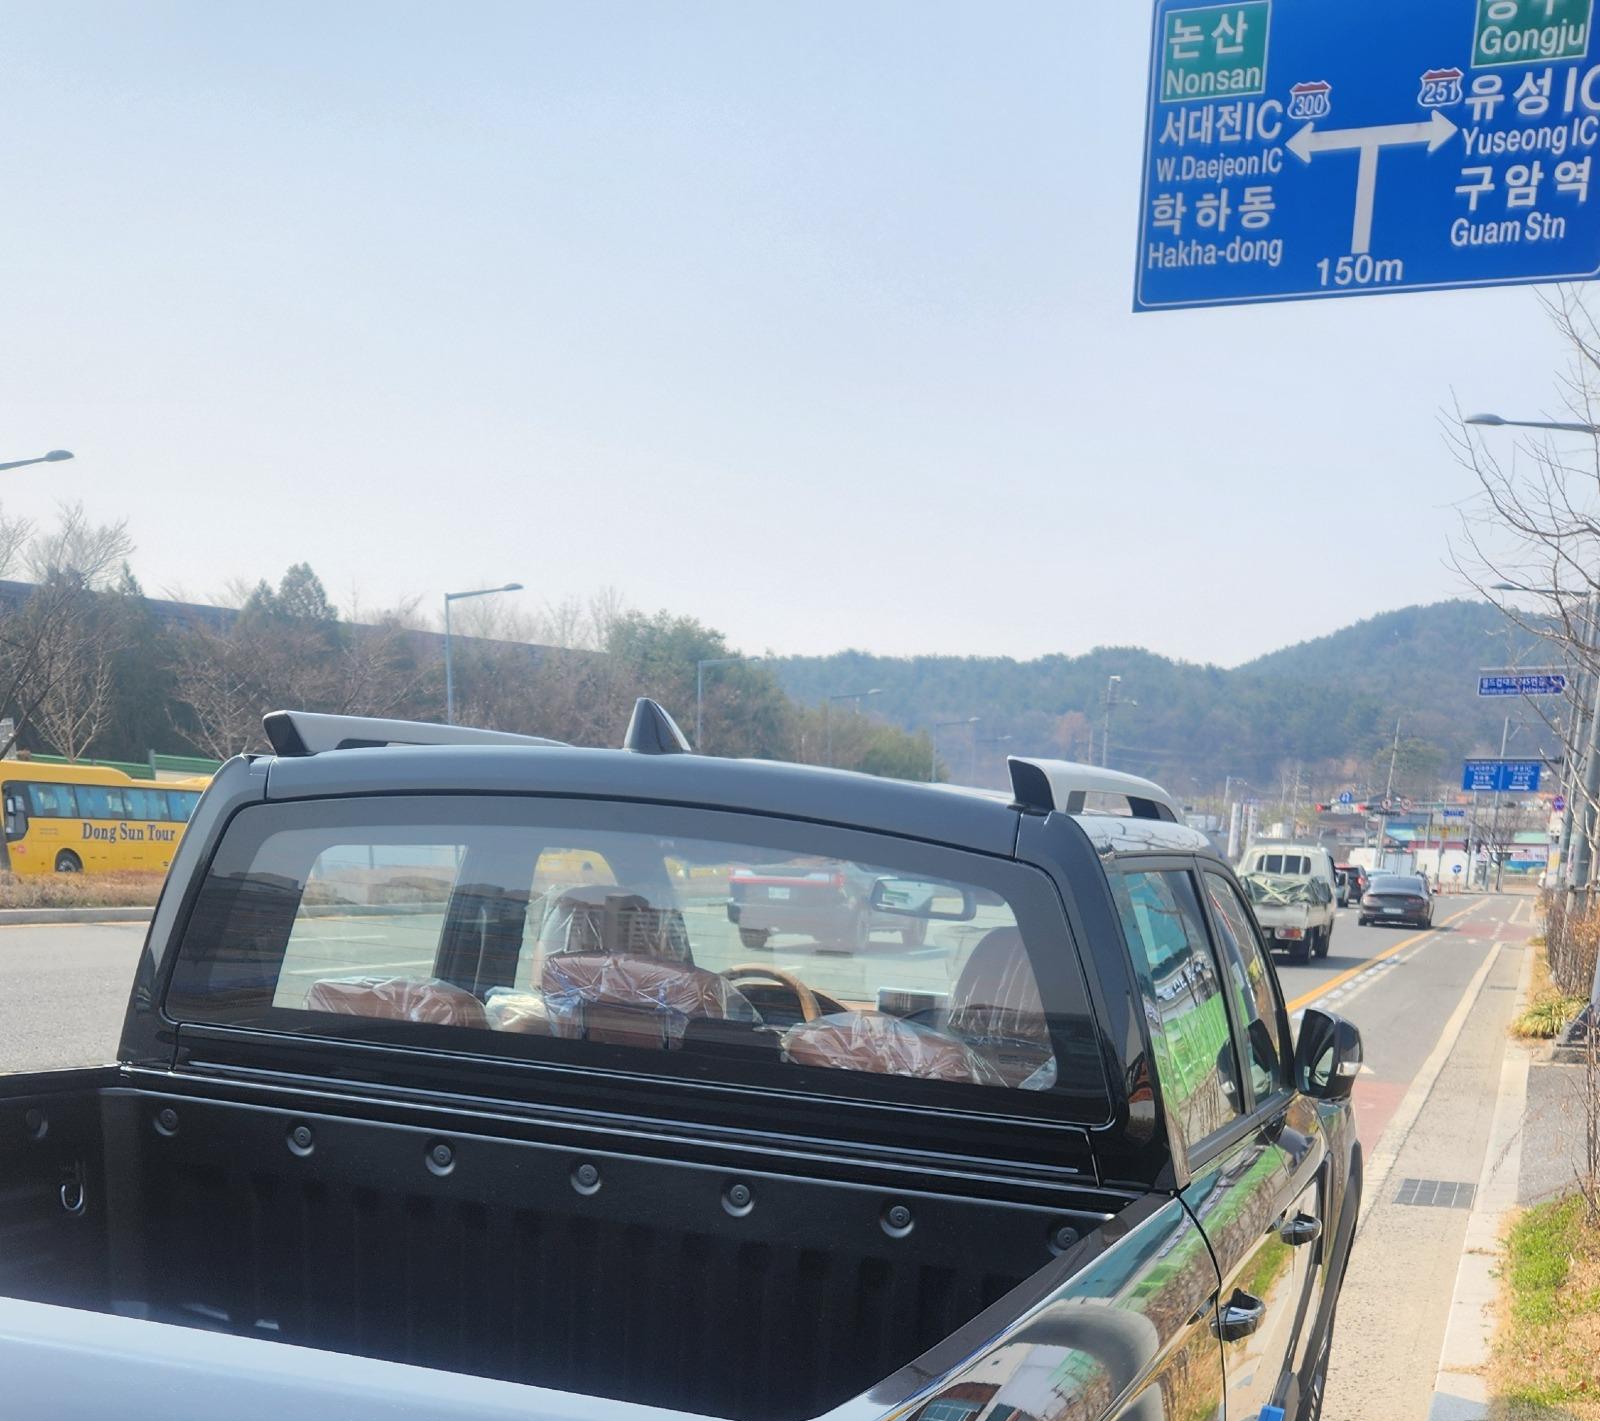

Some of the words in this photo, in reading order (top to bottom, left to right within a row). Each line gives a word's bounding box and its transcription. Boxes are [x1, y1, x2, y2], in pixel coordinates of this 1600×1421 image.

[1169, 10, 1249, 60] 논산
[1480, 18, 1585, 55] Gongju
[1165, 64, 1261, 96] Nonsan
[1424, 80, 1457, 103] 251
[1294, 95, 1325, 116] 300
[1463, 126, 1569, 157] Yuseong
[1571, 118, 1599, 147] IC
[1454, 156, 1592, 211] 구암역
[1152, 185, 1276, 236] 학하동
[1450, 218, 1522, 247] Guam
[1525, 212, 1566, 241] Stn
[1147, 237, 1284, 270] Hakha-dong
[1316, 255, 1404, 286] 150m
[82, 822, 117, 843] Dong
[120, 822, 144, 841] Sun
[147, 824, 176, 841] Tour
